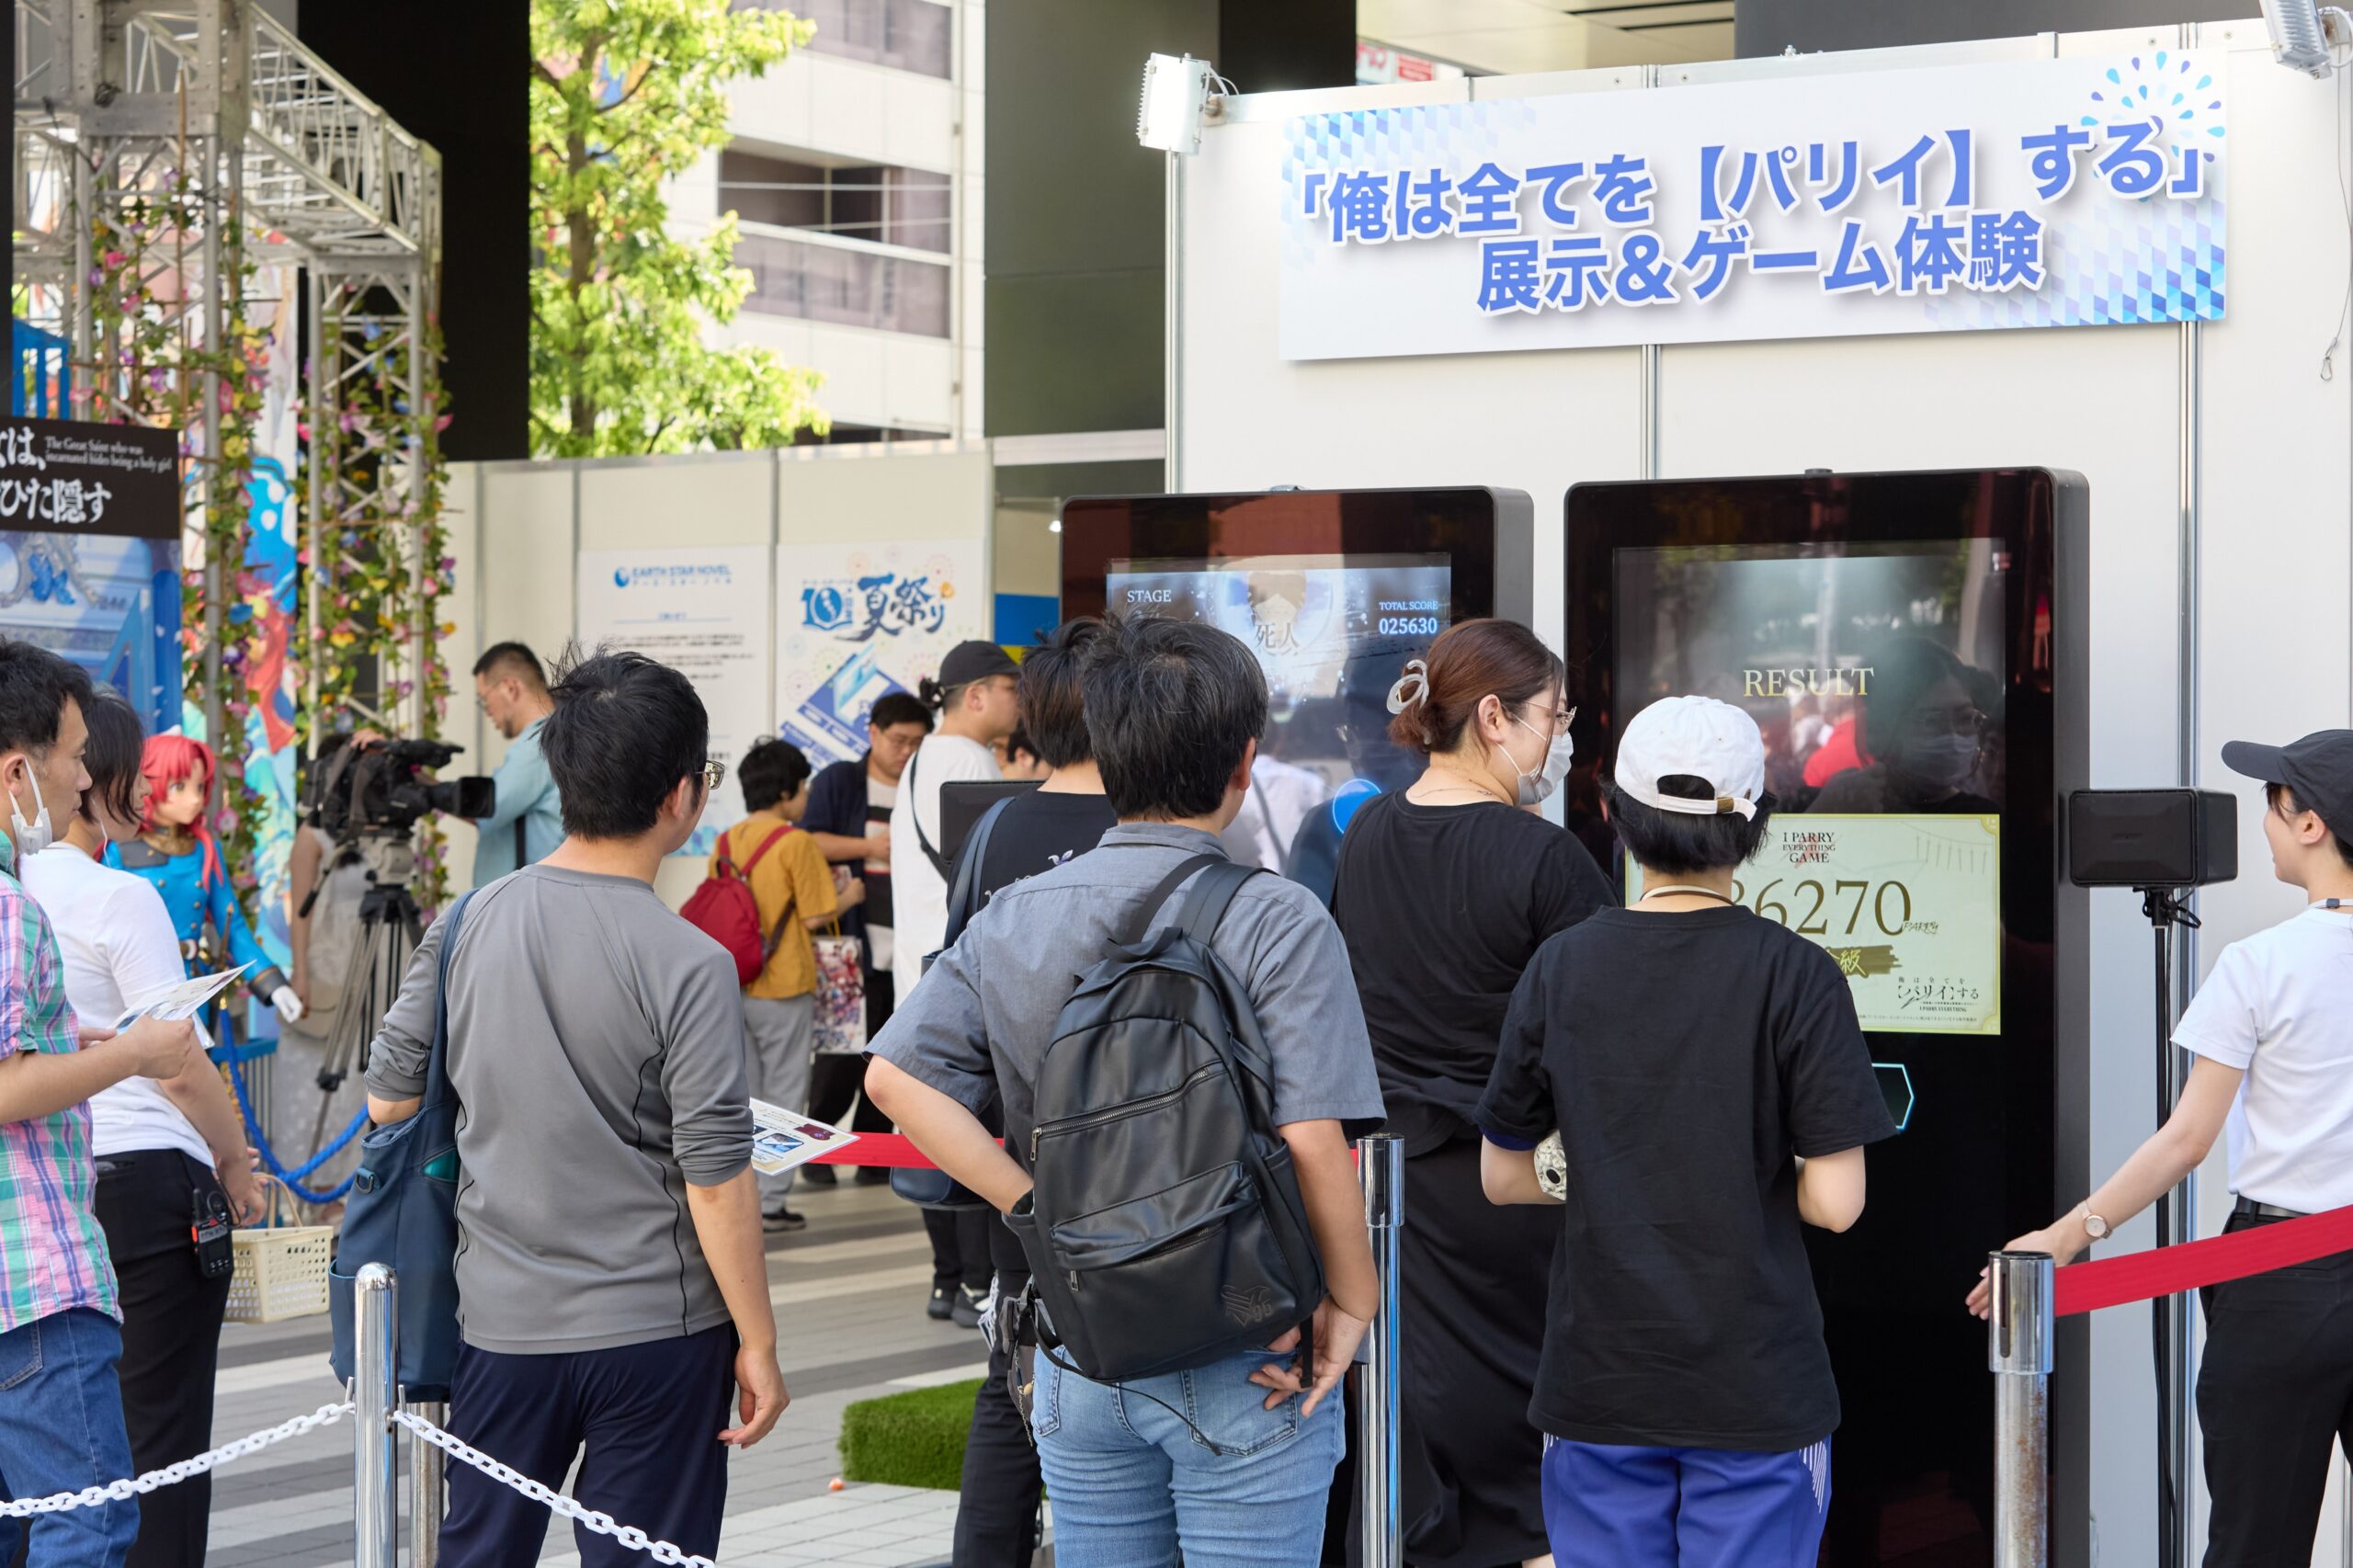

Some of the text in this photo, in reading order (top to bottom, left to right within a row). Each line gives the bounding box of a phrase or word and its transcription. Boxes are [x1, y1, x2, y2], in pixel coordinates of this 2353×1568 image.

[1476, 210, 2044, 312] 展示&ゲーム体験
[45, 436, 62, 449] The
[63, 437, 87, 450] Great
[632, 566, 666, 578] EARTH
[670, 565, 695, 576] STAR
[1127, 588, 1173, 603] STAGE
[834, 573, 945, 642] 夏祭り
[1380, 600, 1438, 610] TOTAL SCORE
[1379, 617, 1438, 634] 025630
[1743, 666, 1875, 697] RESULT
[1783, 832, 1835, 843] I PARRY
[1789, 852, 1830, 863] GAME
